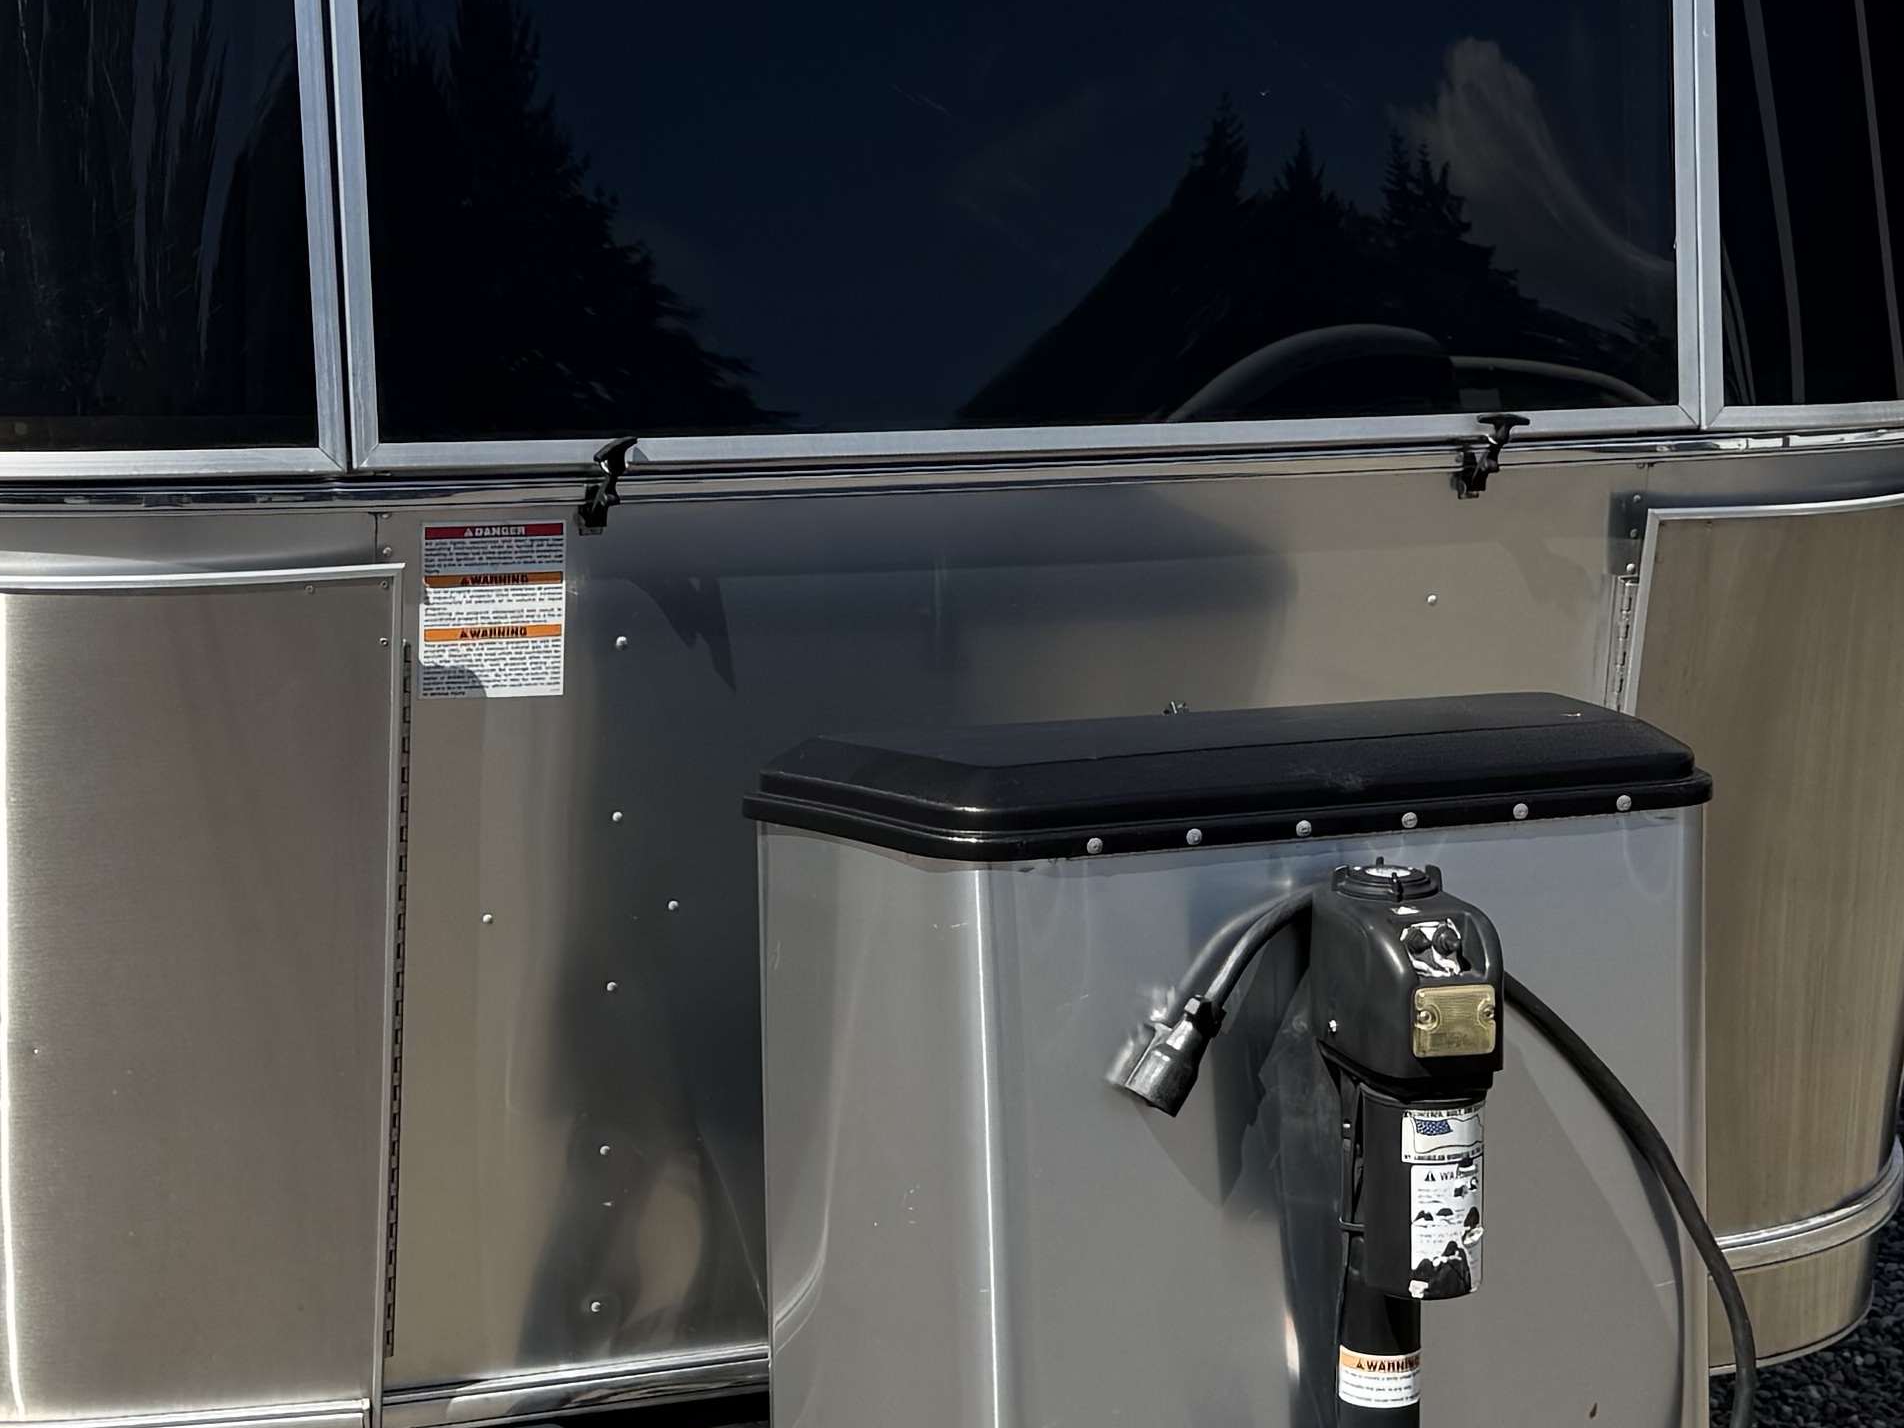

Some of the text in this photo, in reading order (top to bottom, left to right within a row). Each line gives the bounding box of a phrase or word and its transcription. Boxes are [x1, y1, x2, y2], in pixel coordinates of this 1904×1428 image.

[474, 526, 526, 537] DANGER
[470, 573, 529, 585] WARNING
[470, 626, 528, 639] WARNING
